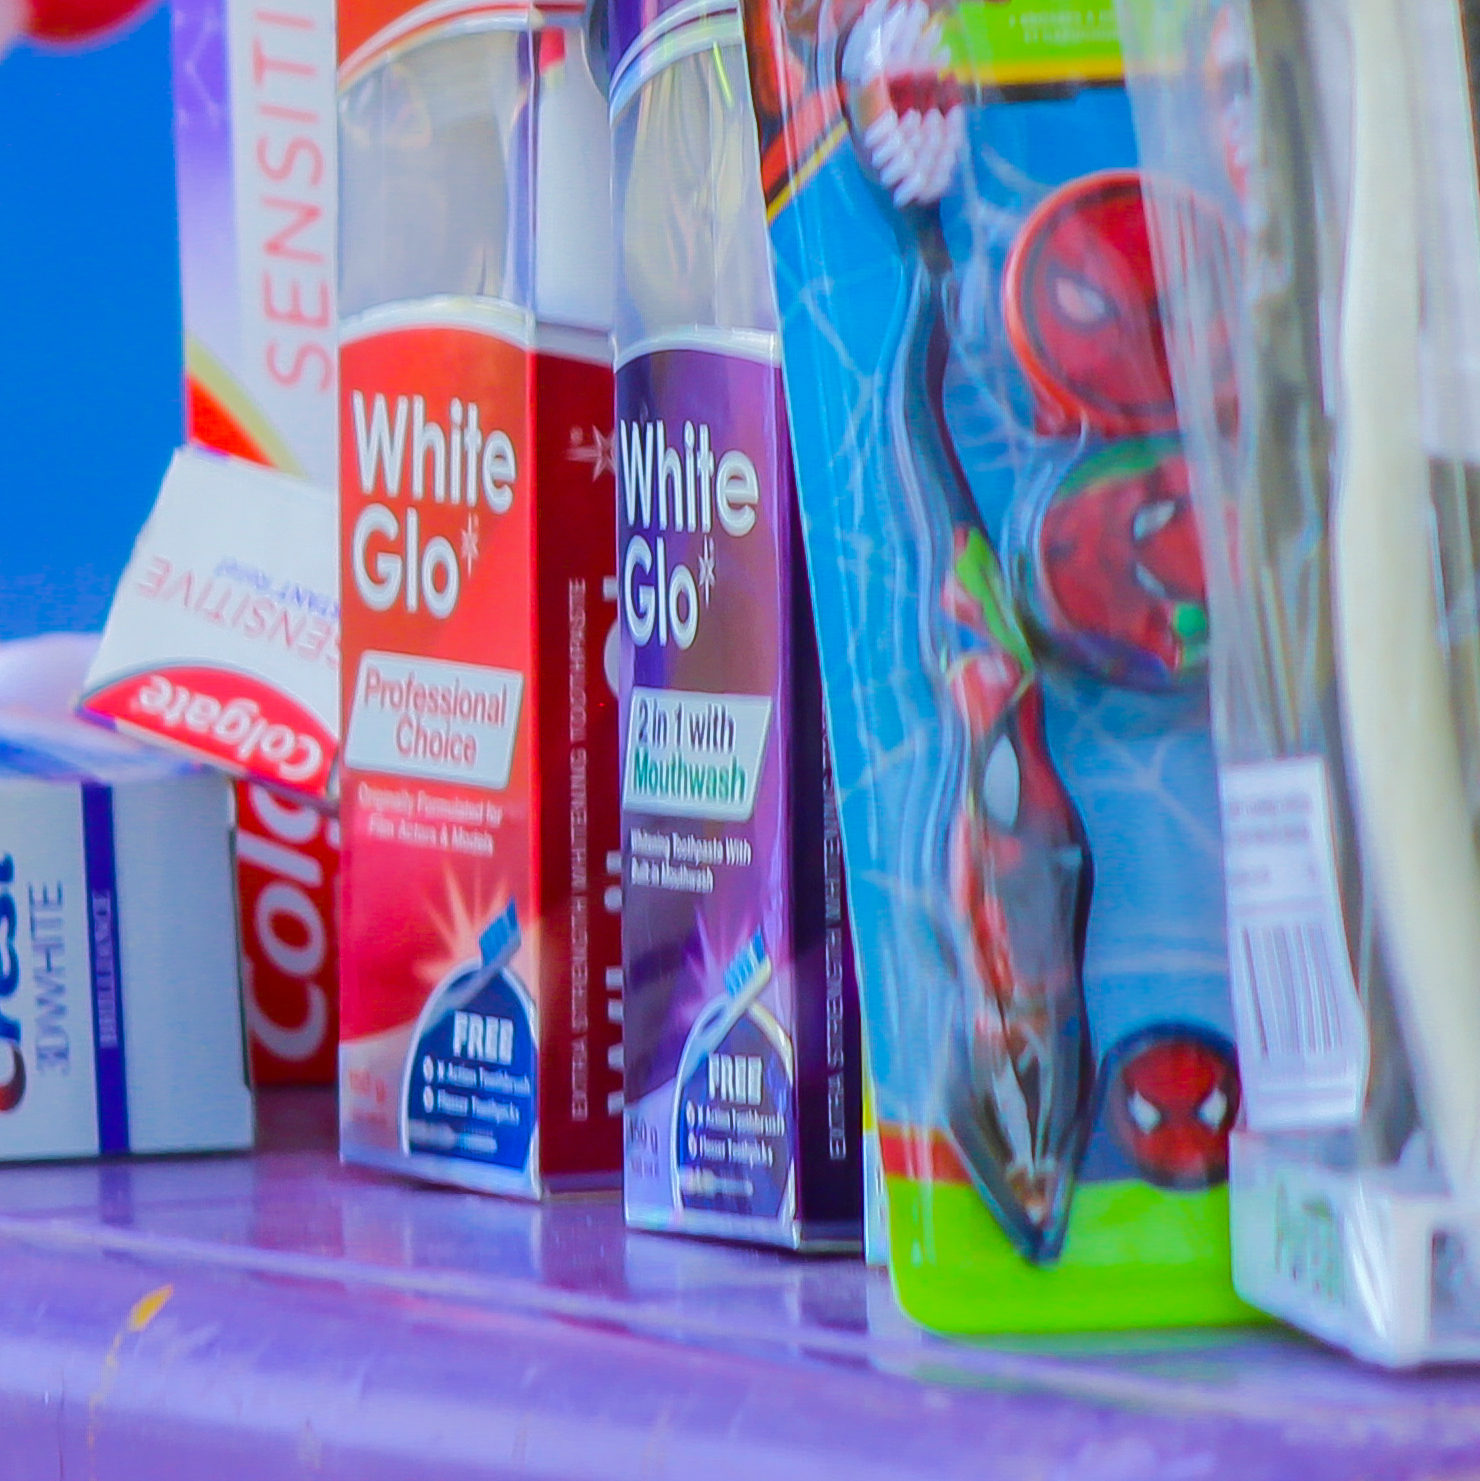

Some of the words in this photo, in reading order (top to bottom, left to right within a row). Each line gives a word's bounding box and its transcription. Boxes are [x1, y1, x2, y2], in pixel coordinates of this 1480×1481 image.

[352, 389, 516, 514] White
[620, 419, 759, 537] White
[352, 503, 460, 619] Glo
[624, 534, 699, 650] Glo
[137, 673, 323, 782] Colgate
[363, 668, 508, 729] Professional
[396, 714, 478, 768] Choice
[637, 698, 649, 744] 2
[674, 701, 685, 749] 1
[688, 702, 737, 755] with
[633, 746, 748, 805] Mouthwash
[569, 896, 587, 1036] STRENGTH
[825, 928, 845, 1070] STRENGTH
[453, 1010, 514, 1066] FREE
[708, 1053, 763, 1106] FREE
[827, 1071, 848, 1161] EXTRA
